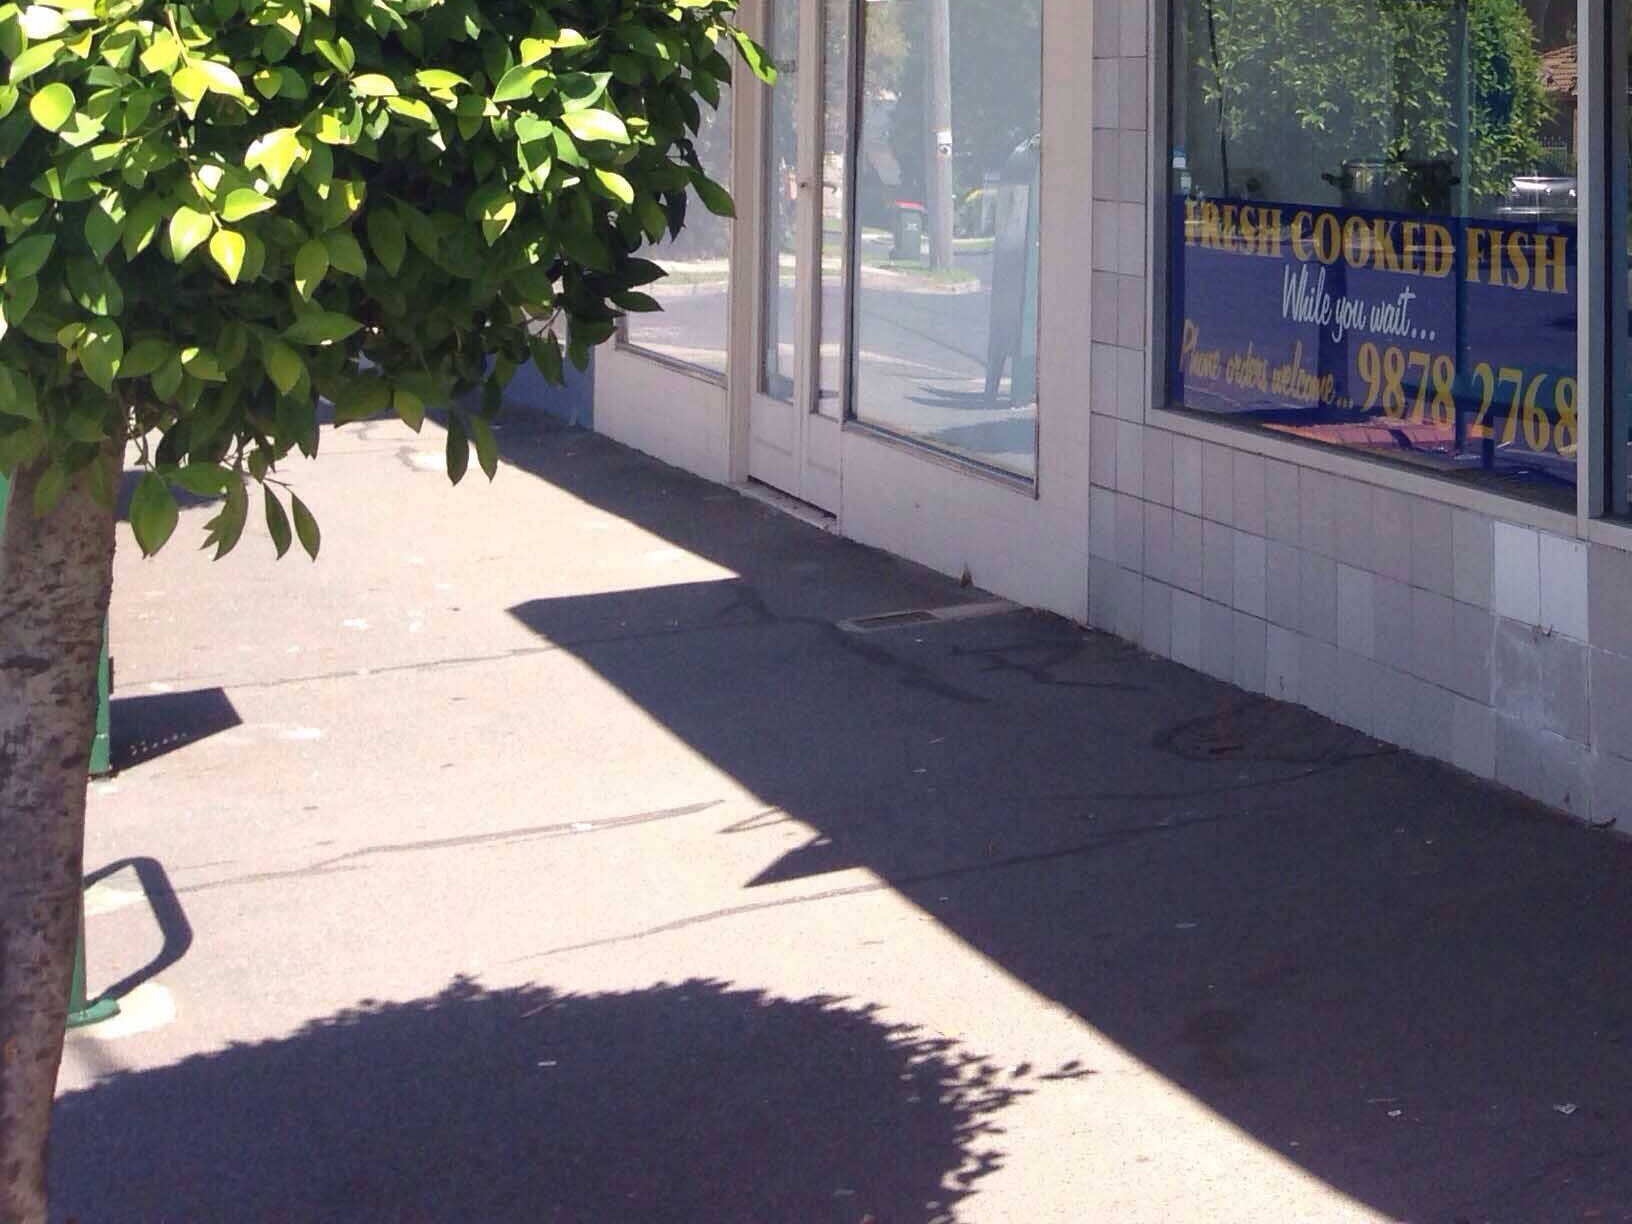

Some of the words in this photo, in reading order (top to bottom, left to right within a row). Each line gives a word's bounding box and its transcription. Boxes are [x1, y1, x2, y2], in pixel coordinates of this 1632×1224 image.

[1184, 198, 1283, 258] FRESH
[1291, 211, 1455, 278] COOKED
[1465, 227, 1569, 294] FISH
[1282, 263, 1333, 325] While
[1334, 293, 1367, 343] you
[1357, 343, 1456, 428] 9878
[1472, 362, 1578, 457] 2768
